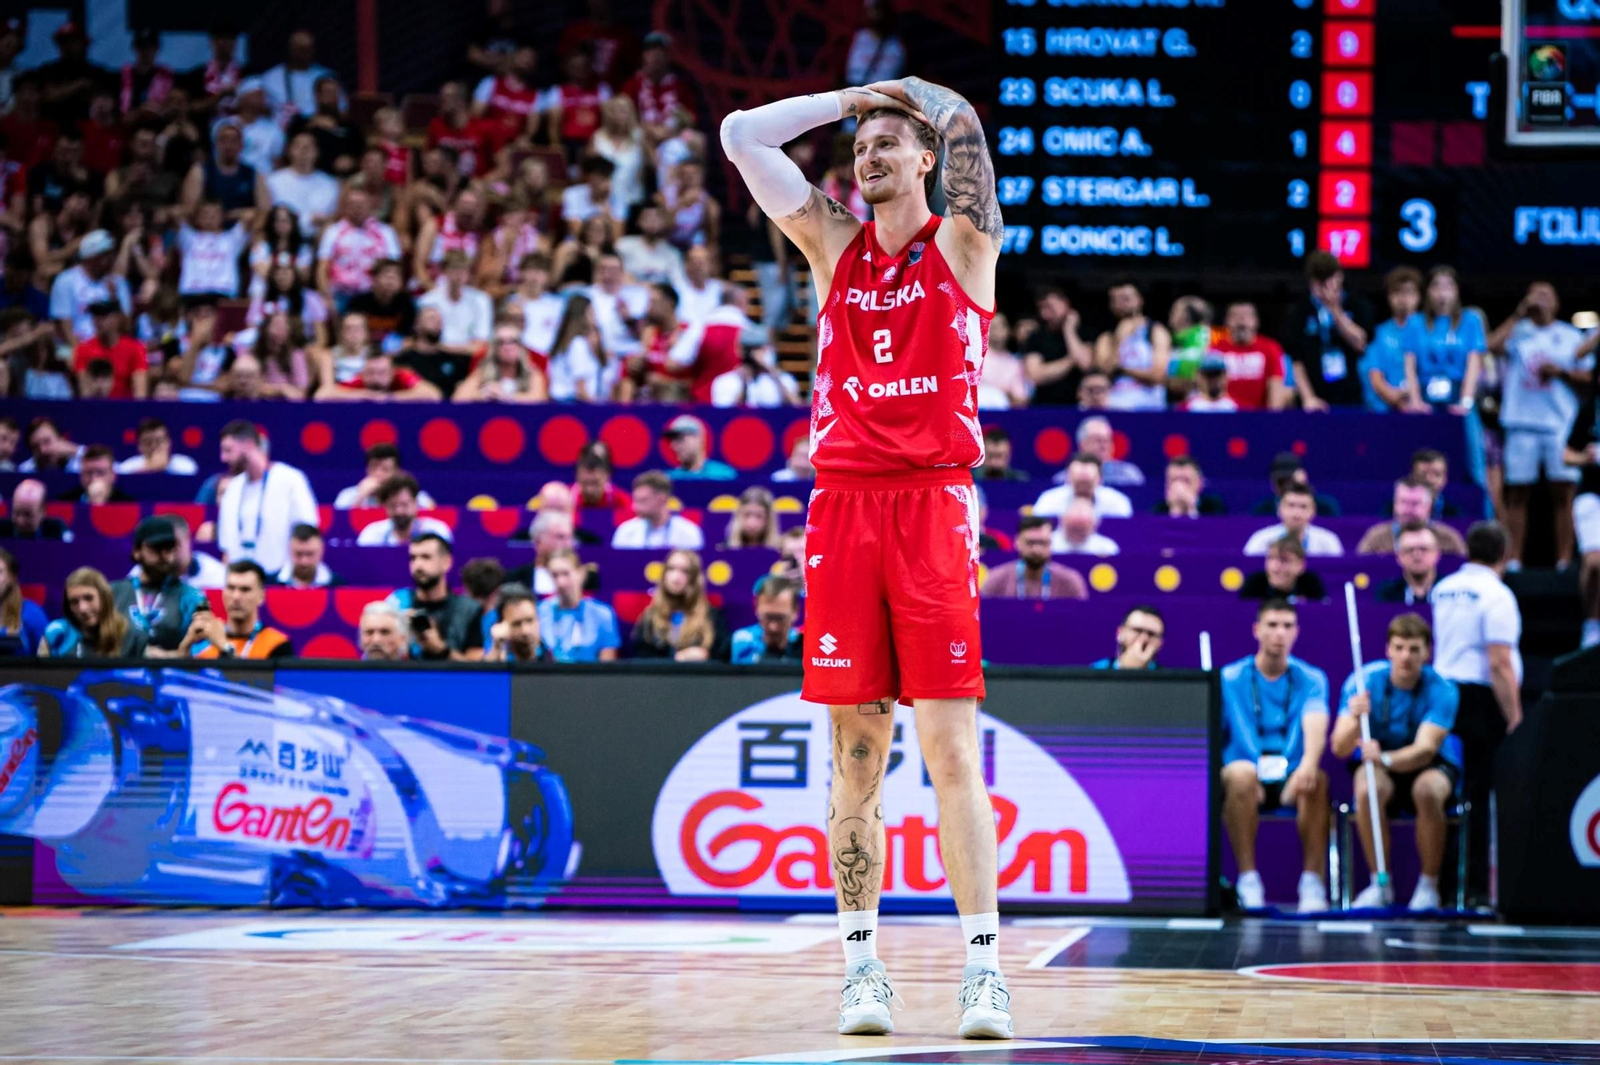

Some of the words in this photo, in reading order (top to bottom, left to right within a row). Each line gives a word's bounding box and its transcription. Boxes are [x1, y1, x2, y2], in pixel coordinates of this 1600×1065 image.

[1045, 27, 1161, 57] HROVAT
[1291, 30, 1312, 57] 2
[1000, 77, 1036, 106] 23
[1044, 77, 1144, 107] SCUKA
[1532, 89, 1562, 106] FIBA
[998, 126, 1034, 155] 24
[1042, 126, 1119, 156] OMIC
[1290, 130, 1307, 157] 1
[1335, 130, 1356, 156] 4
[1042, 176, 1180, 206] STERGAR
[1288, 179, 1309, 208] 2
[1334, 180, 1356, 208] 2
[1399, 198, 1438, 252] 3
[1041, 225, 1153, 256] DONCIC
[1287, 229, 1304, 257] 1
[1326, 228, 1361, 257] 17
[845, 280, 926, 311] POLSKA
[873, 329, 893, 363] 2
[868, 376, 938, 398] ORLEN
[808, 555, 823, 568] 4F
[812, 657, 851, 668] SUZUKI
[680, 790, 1088, 892] Gatn
[847, 930, 873, 941] 4F
[970, 934, 996, 946] 4F
